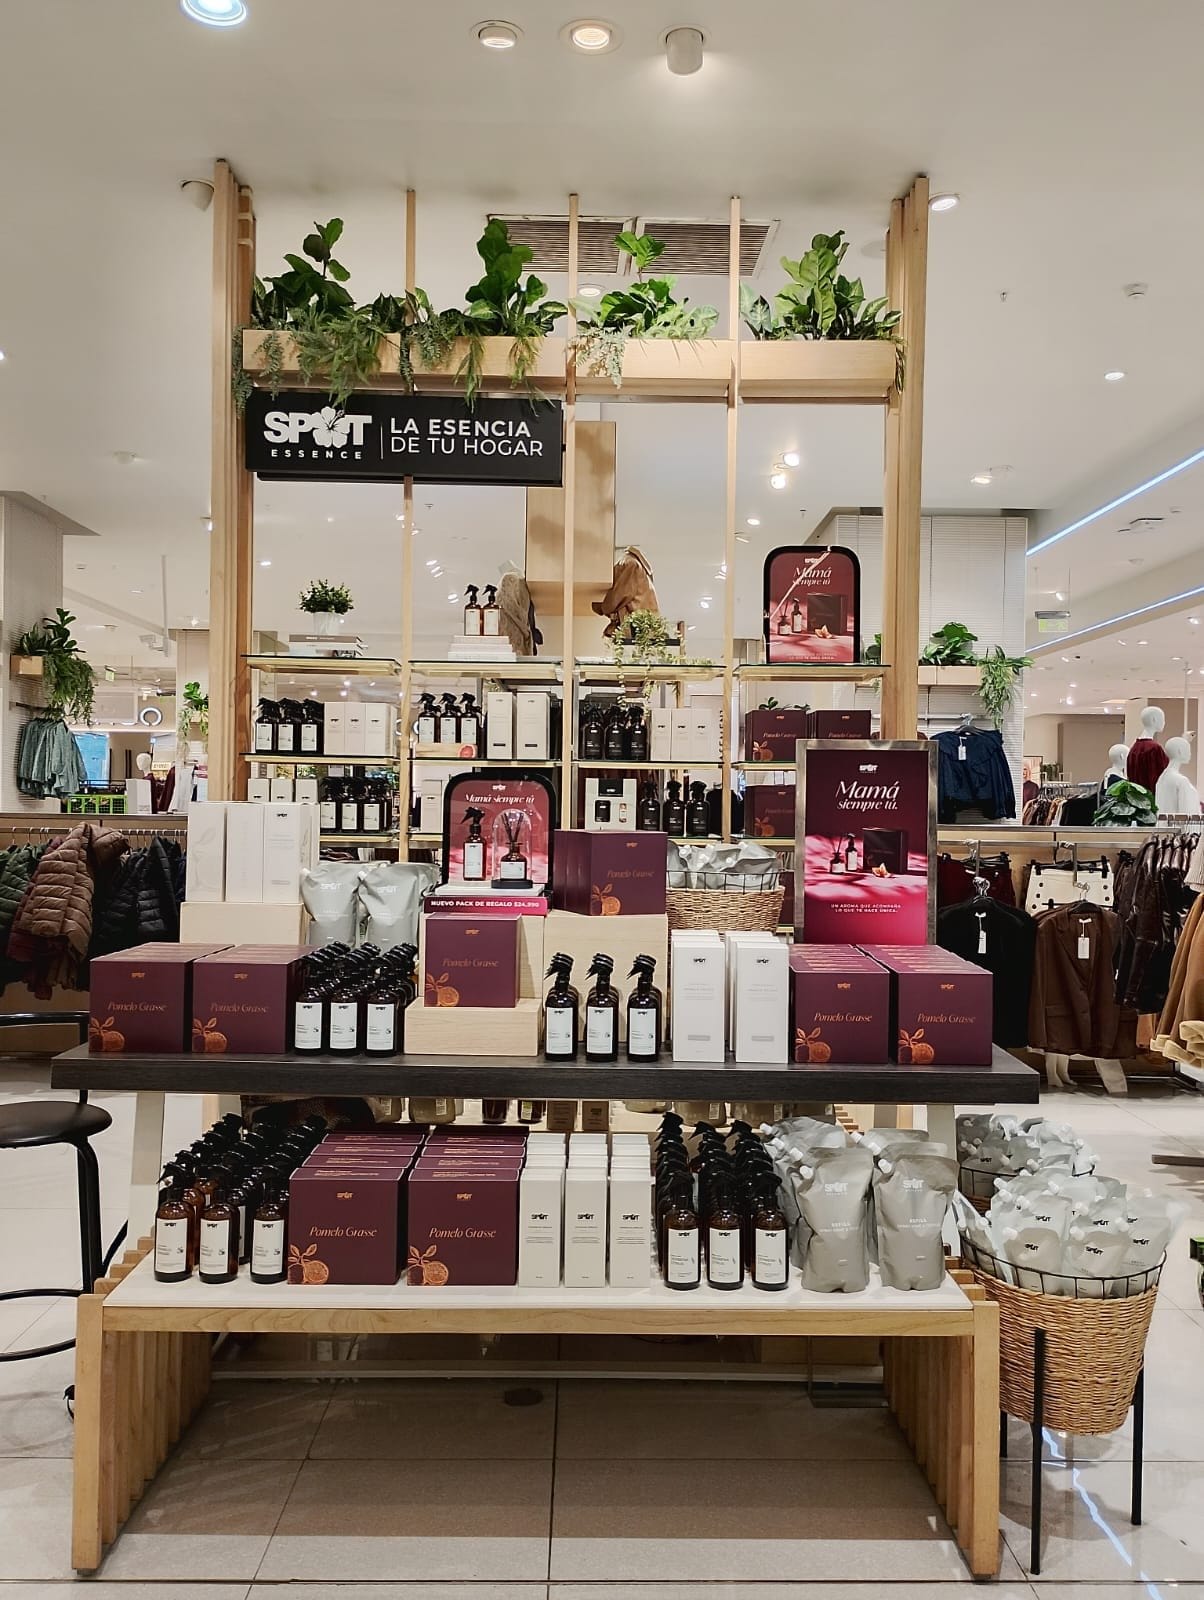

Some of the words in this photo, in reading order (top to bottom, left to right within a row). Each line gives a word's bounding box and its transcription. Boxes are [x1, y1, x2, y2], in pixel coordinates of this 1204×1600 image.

[264, 407, 372, 448] SPOT
[391, 418, 418, 435] LA
[430, 418, 530, 438] ESENCIA
[391, 437, 420, 454] DE
[427, 438, 455, 454] TU
[464, 438, 542, 457] HOGAR
[271, 449, 362, 460] ESSENCE
[836, 780, 900, 799] Mamá
[466, 794, 491, 802] Mamá
[837, 799, 883, 812] siempre
[884, 798, 898, 810] tú.
[442, 958, 472, 967] Pomelo
[472, 959, 499, 968] Grasse
[107, 1002, 137, 1011] Pomelo
[814, 1012, 844, 1022] Pomelo
[846, 1013, 872, 1022] Grasse
[917, 1013, 947, 1023] Pomelo
[949, 1014, 976, 1023] Grasse
[825, 1182, 848, 1192] SPOT
[903, 1178, 924, 1189] SPOT
[310, 1226, 344, 1236] Pomelo
[345, 1227, 377, 1237] Grasse
[429, 1227, 464, 1238] Pomelo
[465, 1227, 496, 1238] Grasse
